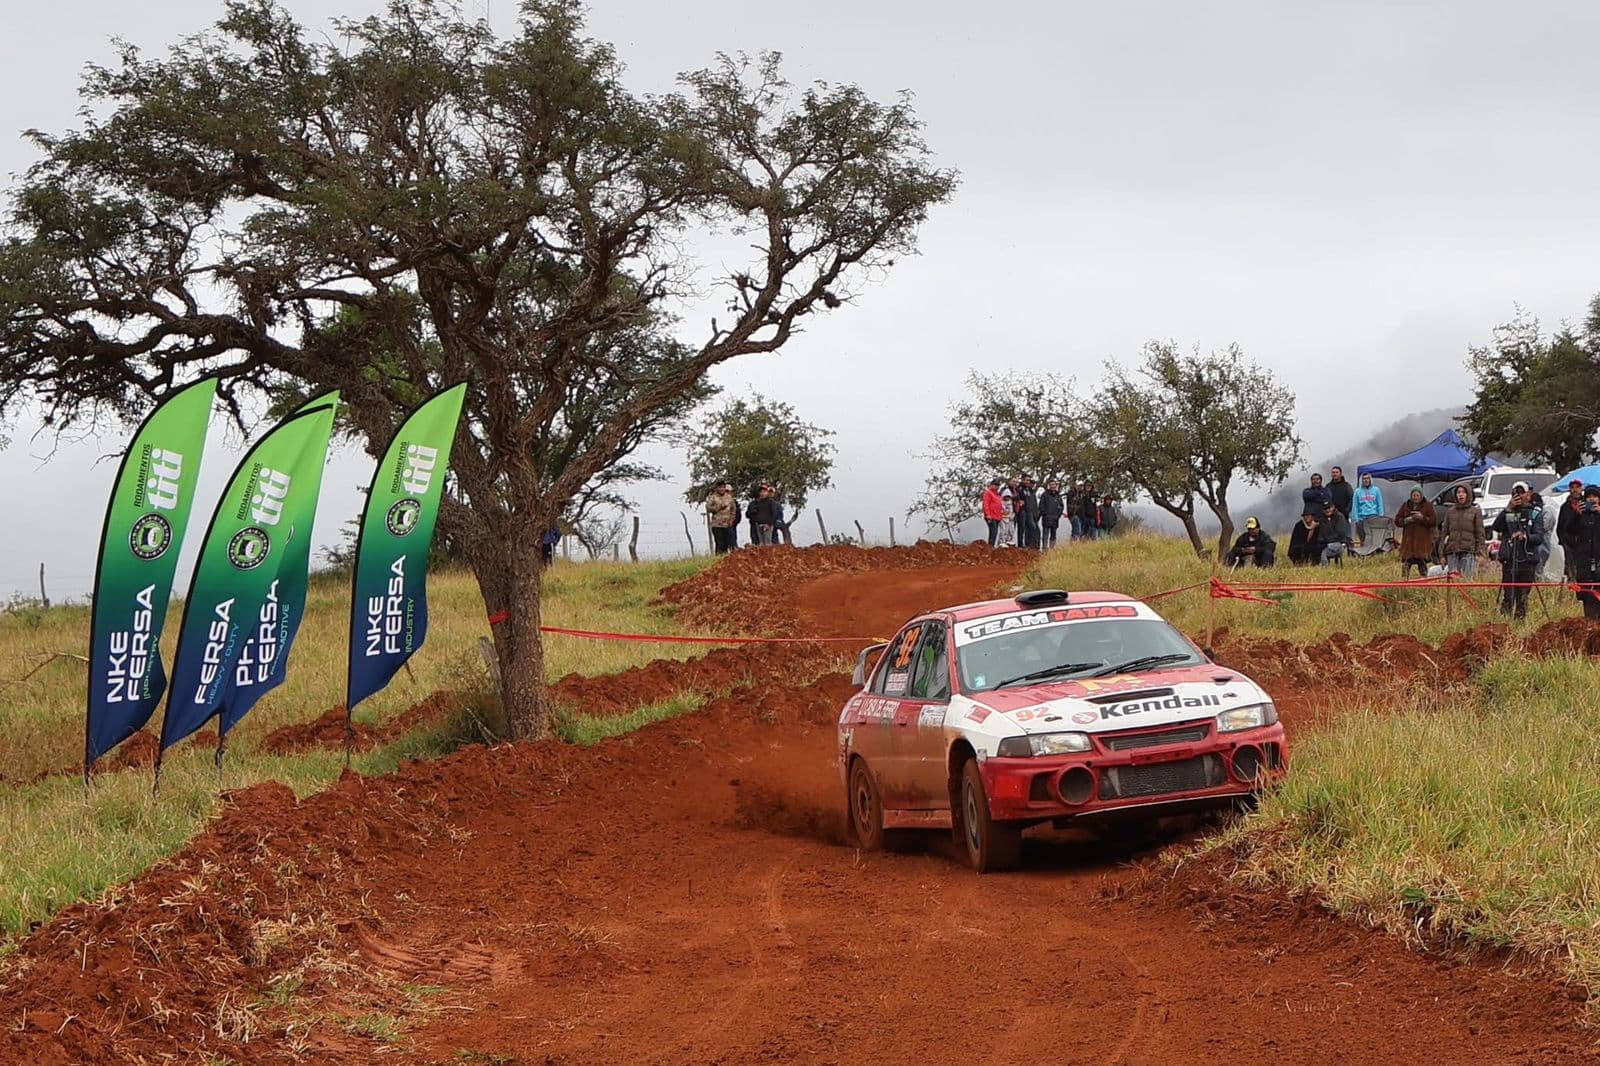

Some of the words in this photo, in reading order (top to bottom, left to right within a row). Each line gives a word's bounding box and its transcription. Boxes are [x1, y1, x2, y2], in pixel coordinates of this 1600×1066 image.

[134, 443, 150, 508] RODAMIENTOS
[236, 462, 260, 520] RODAMIENTOS
[391, 441, 407, 494] RODAMIENTOS
[258, 579, 280, 683] FERSA
[366, 596, 384, 657] NKE
[385, 555, 406, 654] FERSA
[405, 598, 416, 653] INDUSTRY
[964, 612, 1049, 639] TEAM
[1051, 606, 1138, 622] TATAS
[107, 631, 128, 703] NKE
[127, 584, 156, 701] FERSA
[194, 598, 235, 704] FERSA
[225, 623, 240, 657] DUTY
[1015, 706, 1051, 721] 92
[1100, 695, 1221, 720] Kendall
